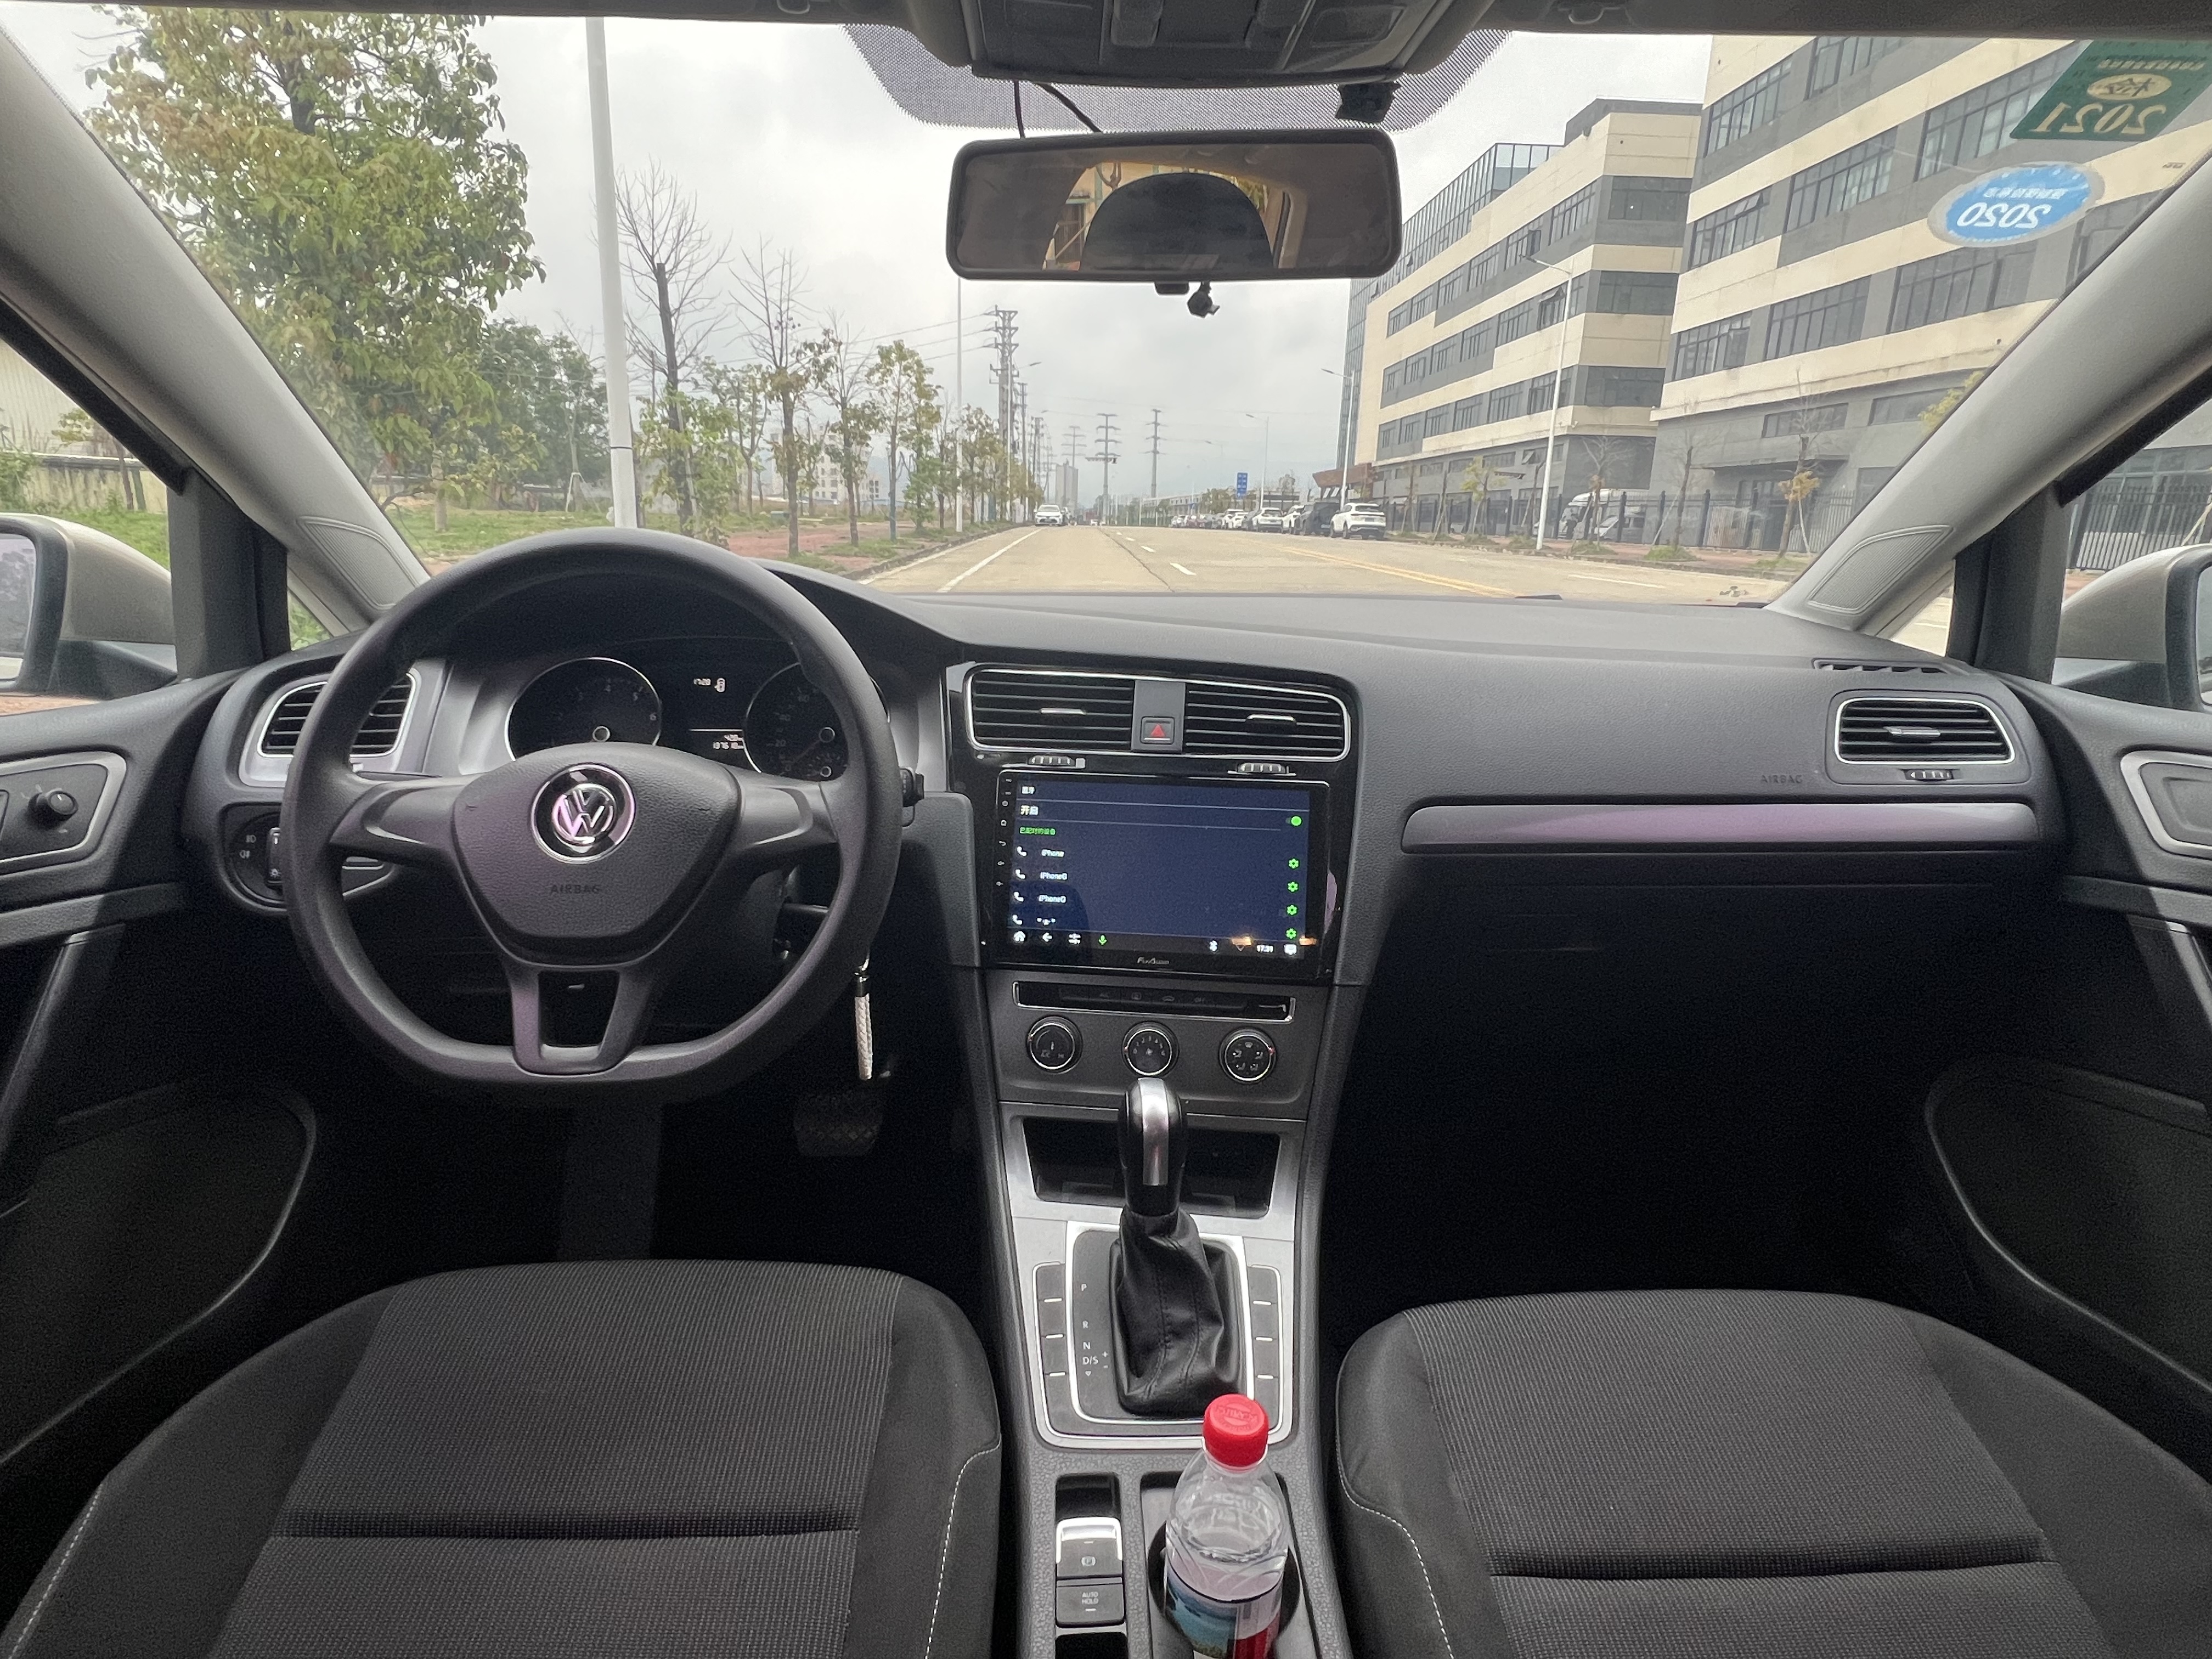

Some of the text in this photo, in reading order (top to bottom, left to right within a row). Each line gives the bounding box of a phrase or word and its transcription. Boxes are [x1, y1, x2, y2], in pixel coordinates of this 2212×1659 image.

[649, 712, 657, 721] 6
[1761, 774, 1803, 784] AIRBAG
[1041, 849, 1065, 857] iPhone
[550, 884, 600, 894] AIRBAG
[1081, 1283, 1087, 1291] P
[1082, 1320, 1089, 1329] R
[1083, 1341, 1091, 1350] N
[1082, 1355, 1099, 1365] D/S
